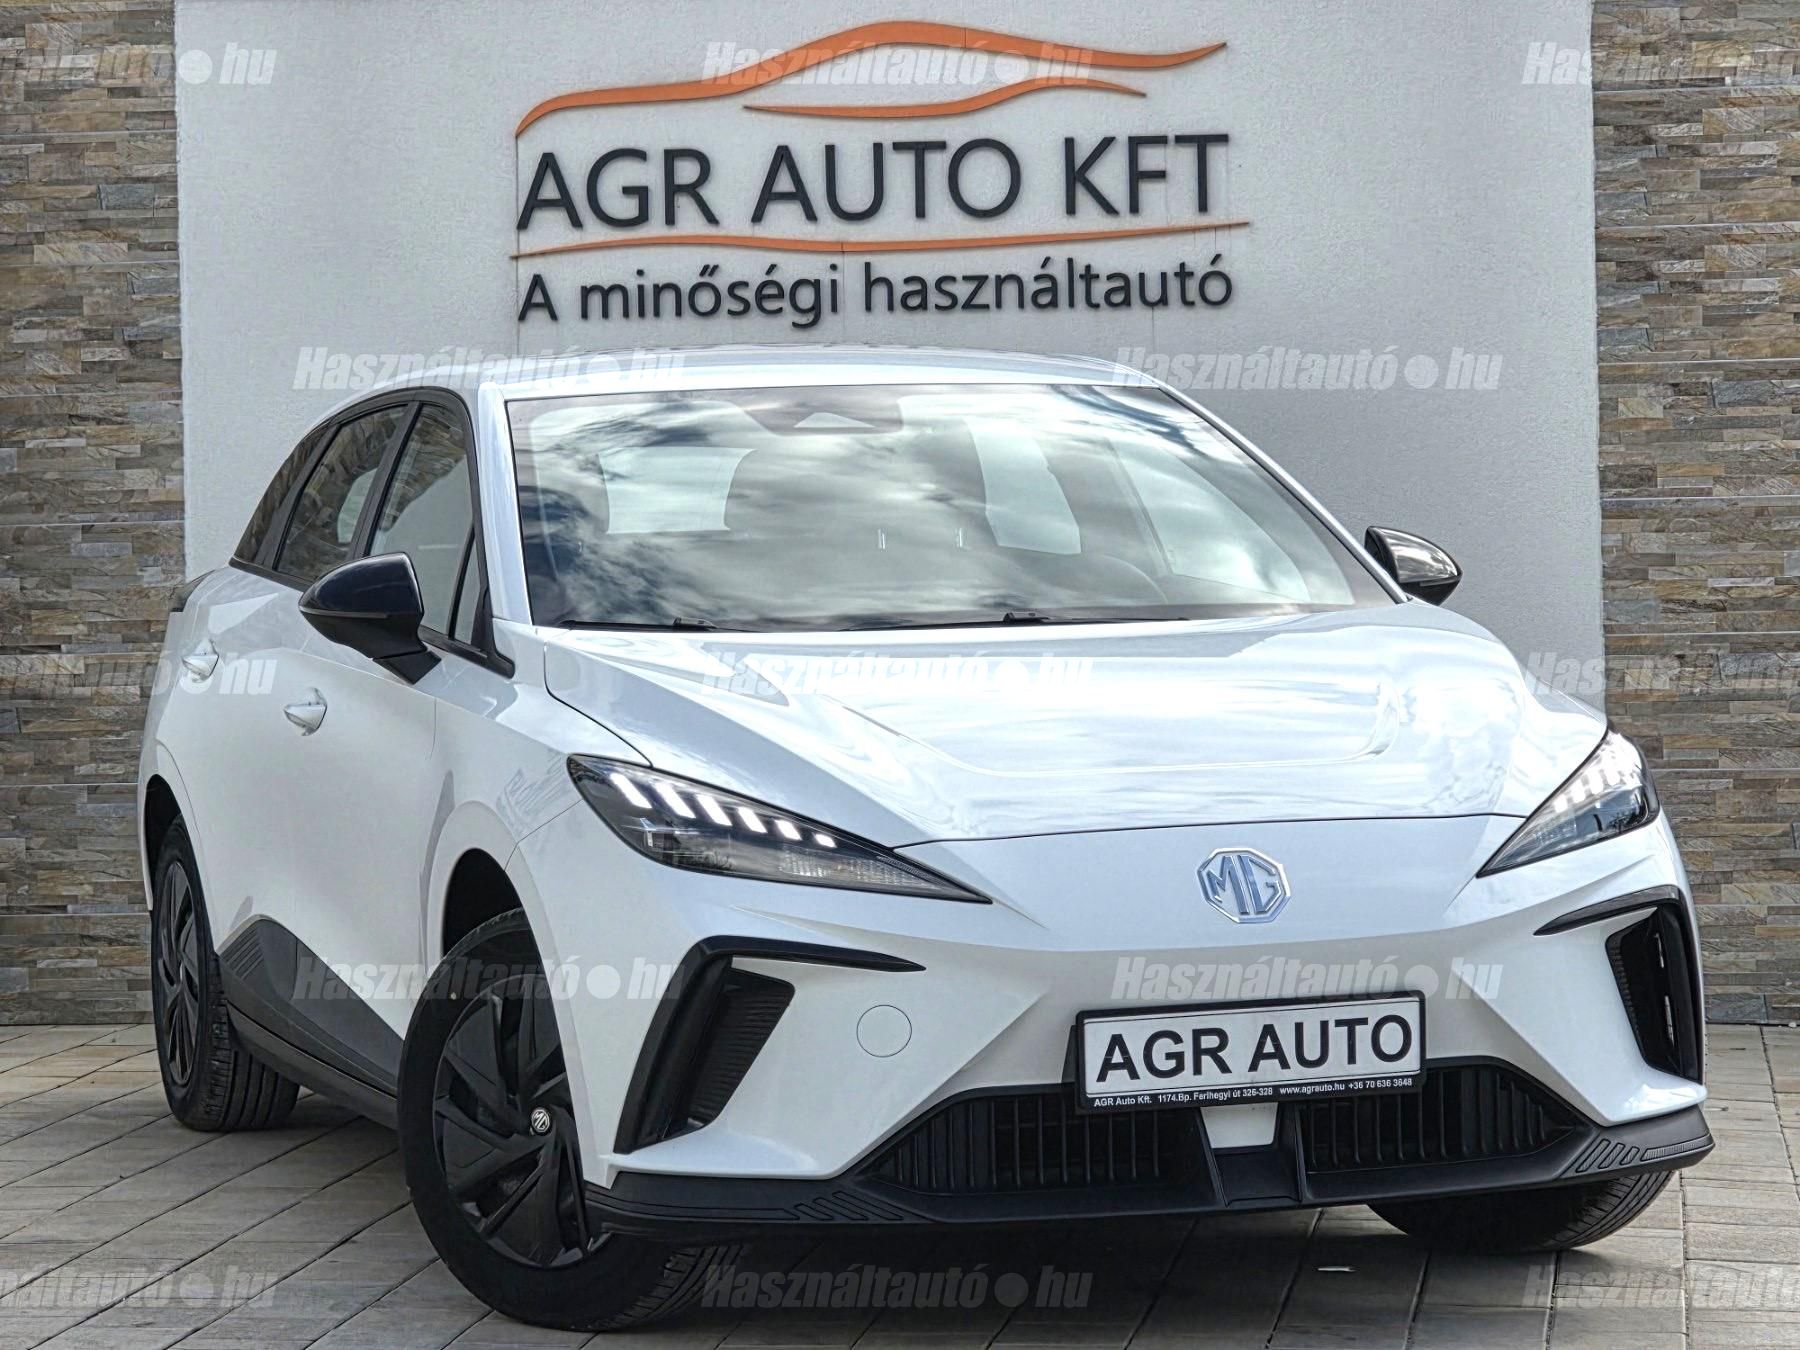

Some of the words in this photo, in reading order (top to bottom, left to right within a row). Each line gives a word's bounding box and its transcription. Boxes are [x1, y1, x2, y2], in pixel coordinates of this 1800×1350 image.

[516, 147, 720, 231] AGR
[751, 137, 1022, 224] AUTO
[1063, 133, 1230, 217] KFT
[517, 272, 558, 323] A
[580, 264, 841, 329] minőségi
[864, 253, 1234, 313] használtautó
[1203, 853, 1282, 916] MG
[1096, 1026, 1233, 1083] AGR
[1247, 1014, 1413, 1073] AUTO
[1094, 1097, 1114, 1107] AGR
[1116, 1096, 1136, 1106] Auto
[1138, 1095, 1152, 1105] Kft.
[1232, 1089, 1241, 1098] út
[1279, 1082, 1346, 1096] www.agrauto.hu
[1348, 1080, 1364, 1090] +36
[1365, 1080, 1376, 1089] 70
